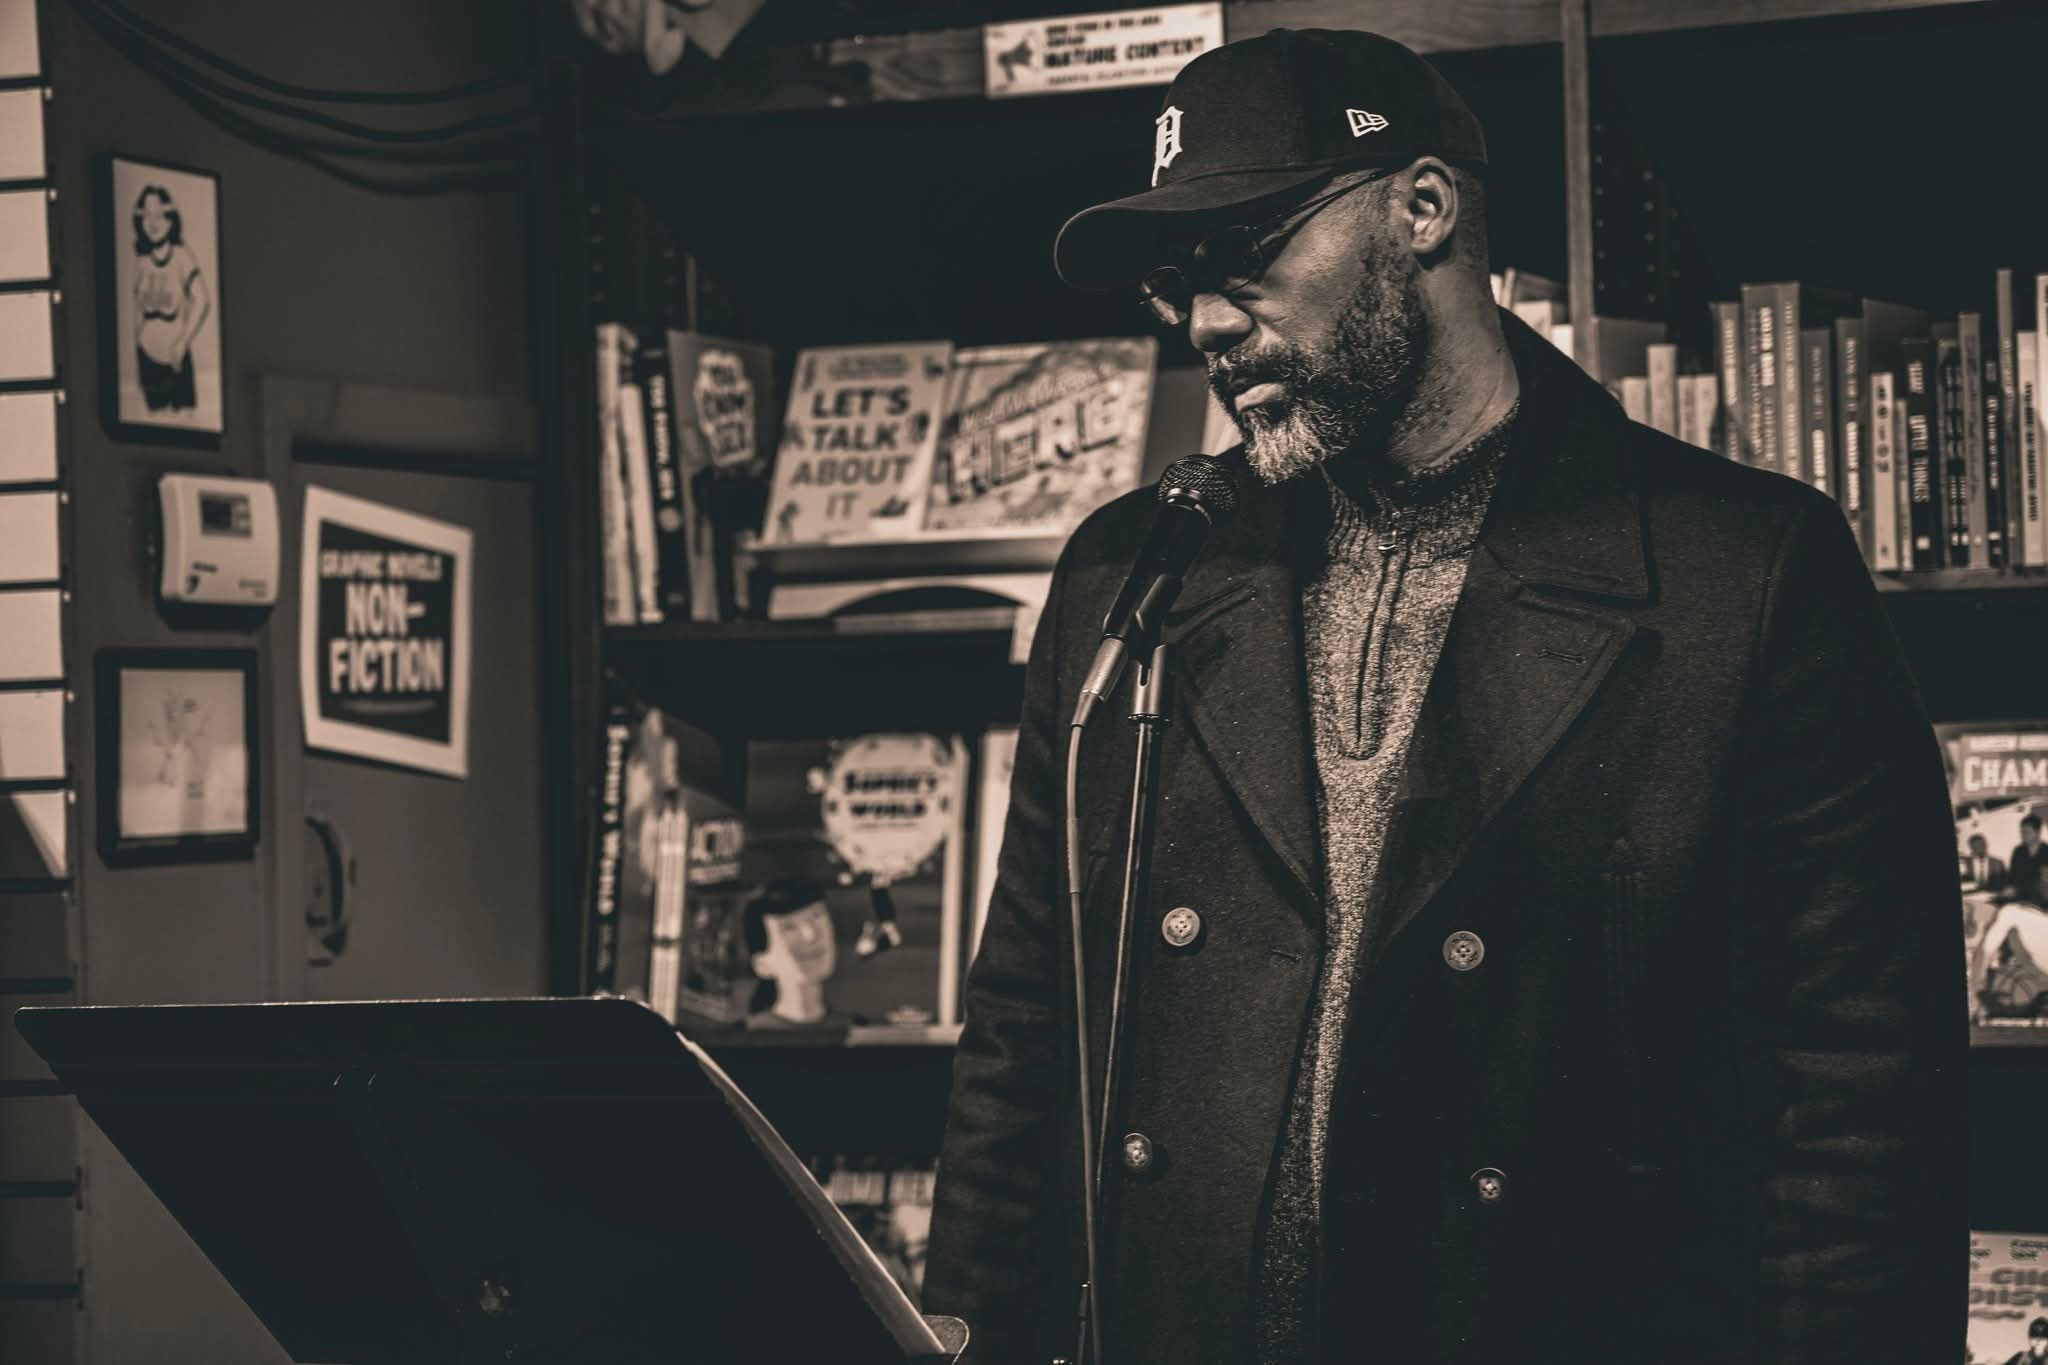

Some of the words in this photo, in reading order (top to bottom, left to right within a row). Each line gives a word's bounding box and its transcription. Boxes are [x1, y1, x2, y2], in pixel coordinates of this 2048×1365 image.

[1043, 46, 1116, 68] MATURE
[1125, 37, 1204, 61] CONTENT
[811, 386, 911, 418] LET'S
[811, 422, 899, 451] TALK
[790, 456, 912, 486] ABOUT
[825, 493, 860, 519] IT
[345, 583, 427, 636] NON-
[329, 637, 444, 693] FICTION
